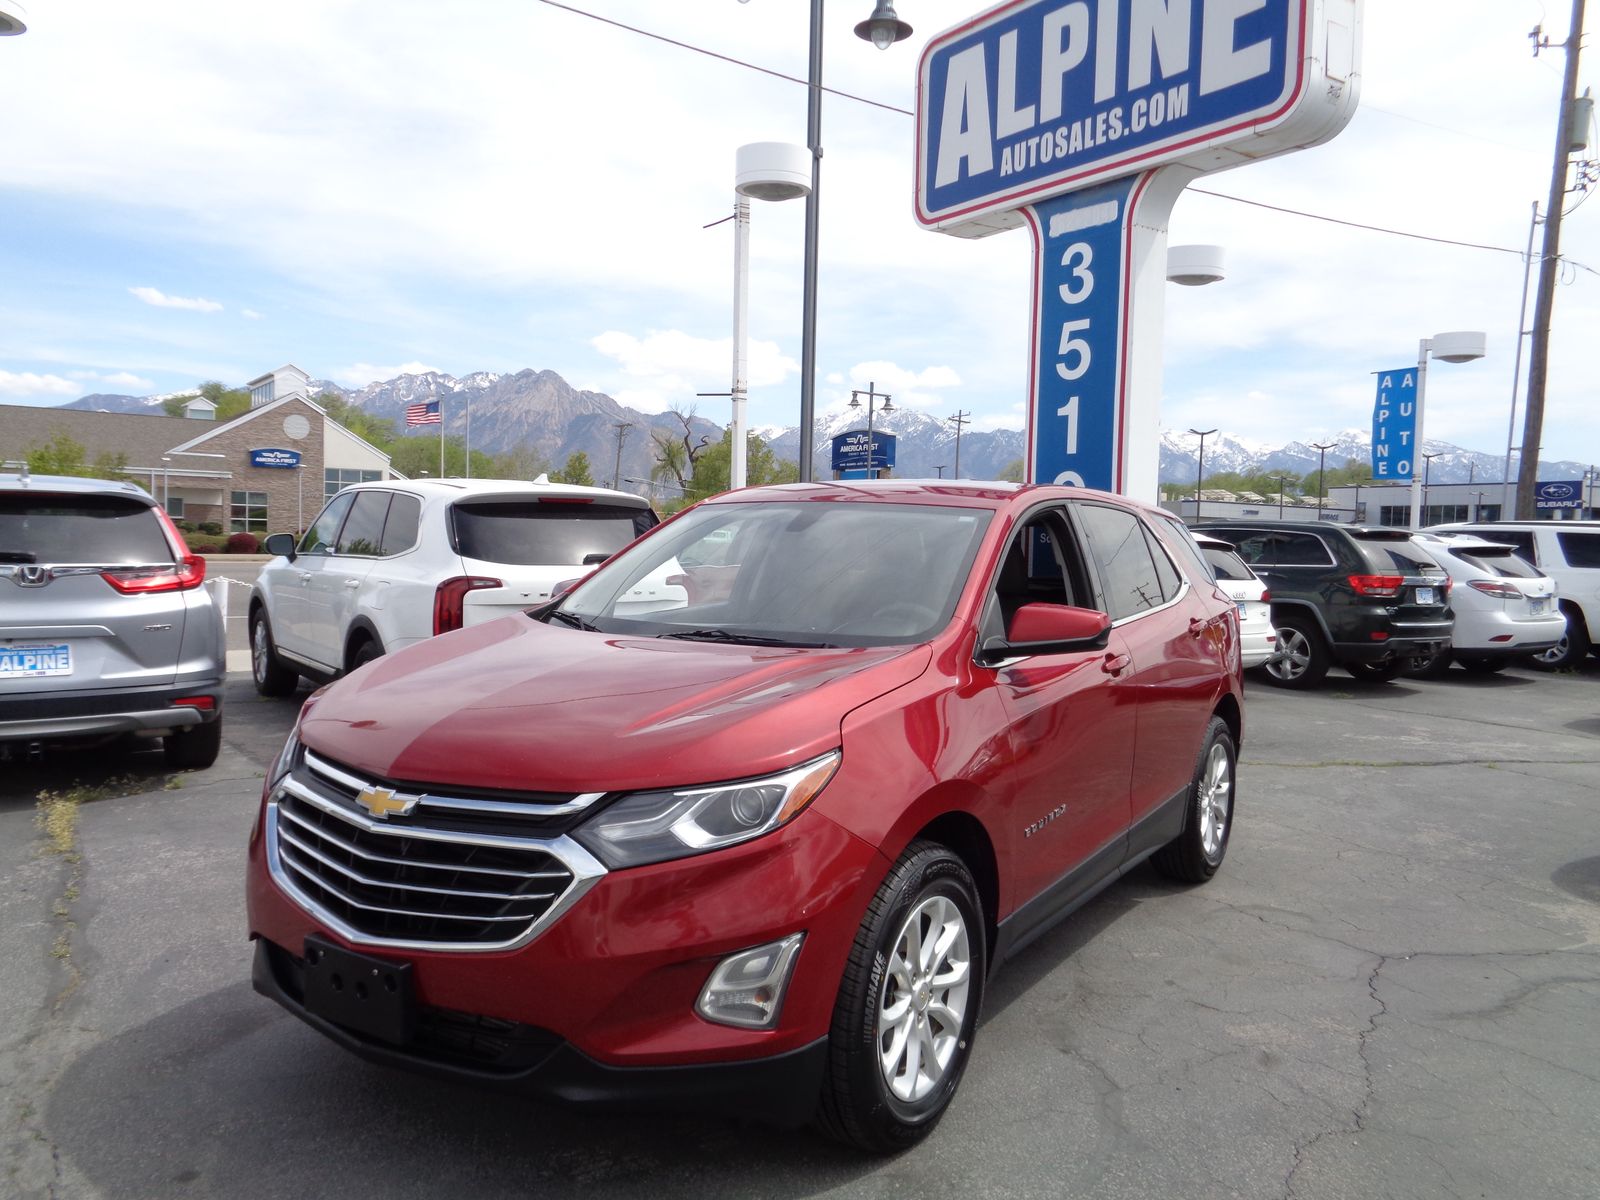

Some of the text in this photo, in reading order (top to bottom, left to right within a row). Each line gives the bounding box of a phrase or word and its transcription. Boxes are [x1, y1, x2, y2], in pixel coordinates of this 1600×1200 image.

[935, 0, 1273, 189] ALPINE
[1000, 84, 1190, 177] AUTOSALES.COM
[863, 443, 879, 451] FIST
[1377, 375, 1392, 475] ALPINE
[1397, 373, 1414, 475] AUTO
[1537, 500, 1577, 508] SUBARU
[0, 655, 69, 671] ALPINE
[864, 950, 886, 1025] MOHAVE
